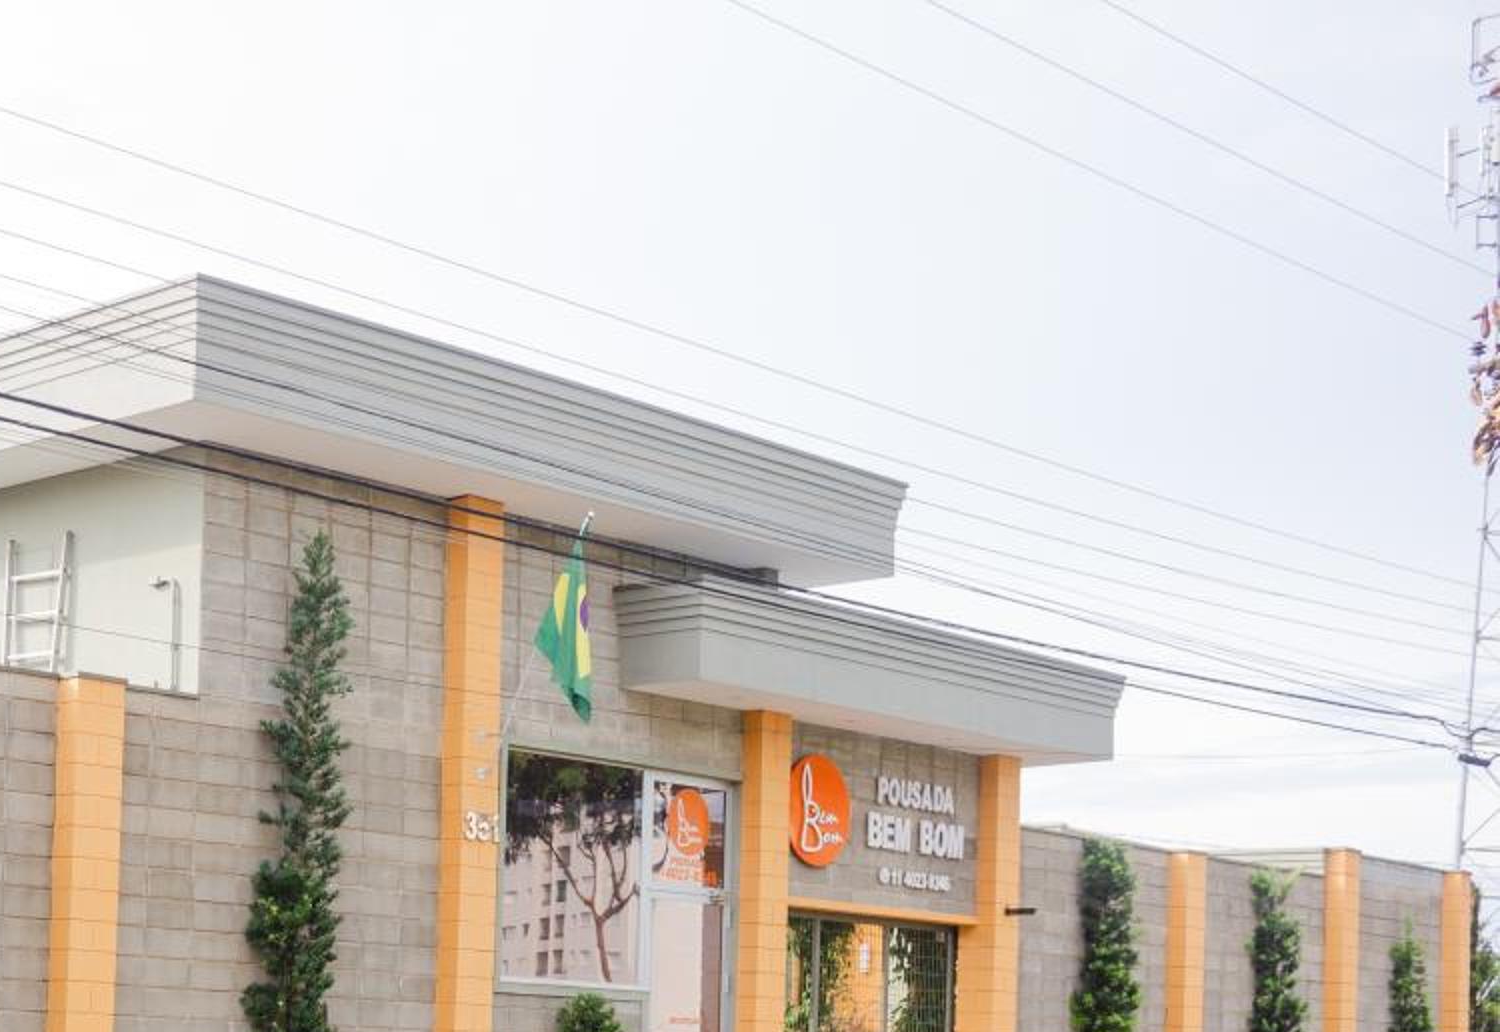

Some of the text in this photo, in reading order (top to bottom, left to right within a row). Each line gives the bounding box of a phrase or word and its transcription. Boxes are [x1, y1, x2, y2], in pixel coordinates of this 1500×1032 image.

[878, 776, 954, 814] POUSADA
[867, 811, 965, 860] BEM BOM
